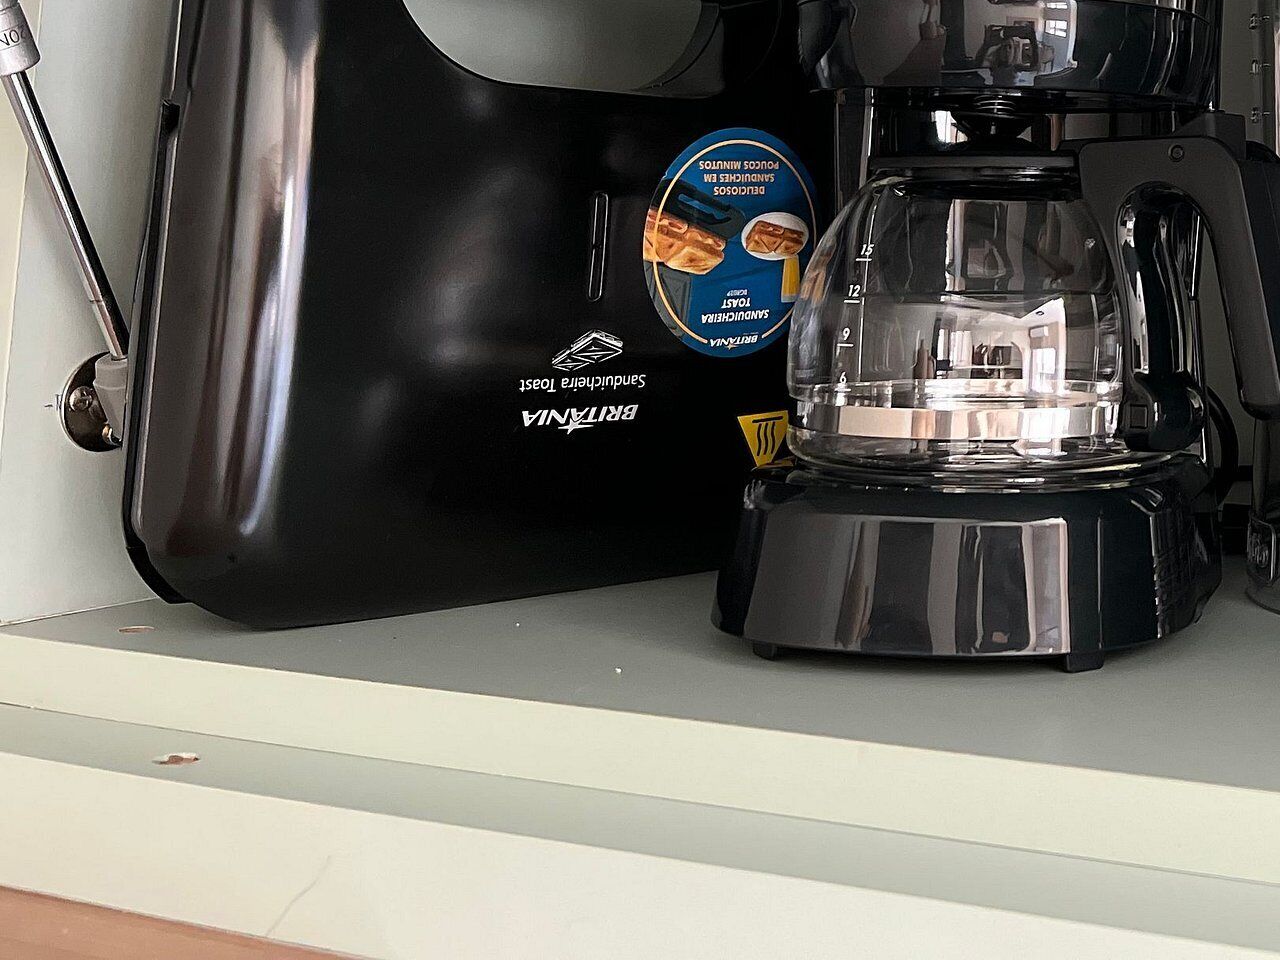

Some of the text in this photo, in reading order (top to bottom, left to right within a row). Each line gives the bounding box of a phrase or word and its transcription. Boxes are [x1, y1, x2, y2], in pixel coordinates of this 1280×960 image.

[699, 160, 780, 170] POUCOS MINUTOS
[703, 173, 717, 183] EM
[713, 186, 765, 195] DELICIOSOS
[860, 243, 875, 256] 15
[848, 284, 861, 297] 12
[721, 298, 751, 309] TOAST
[701, 309, 770, 324] SANDUICHEIRA
[842, 327, 851, 341] 9
[519, 374, 647, 393] Sanduicheira Toast
[839, 371, 847, 384] 6
